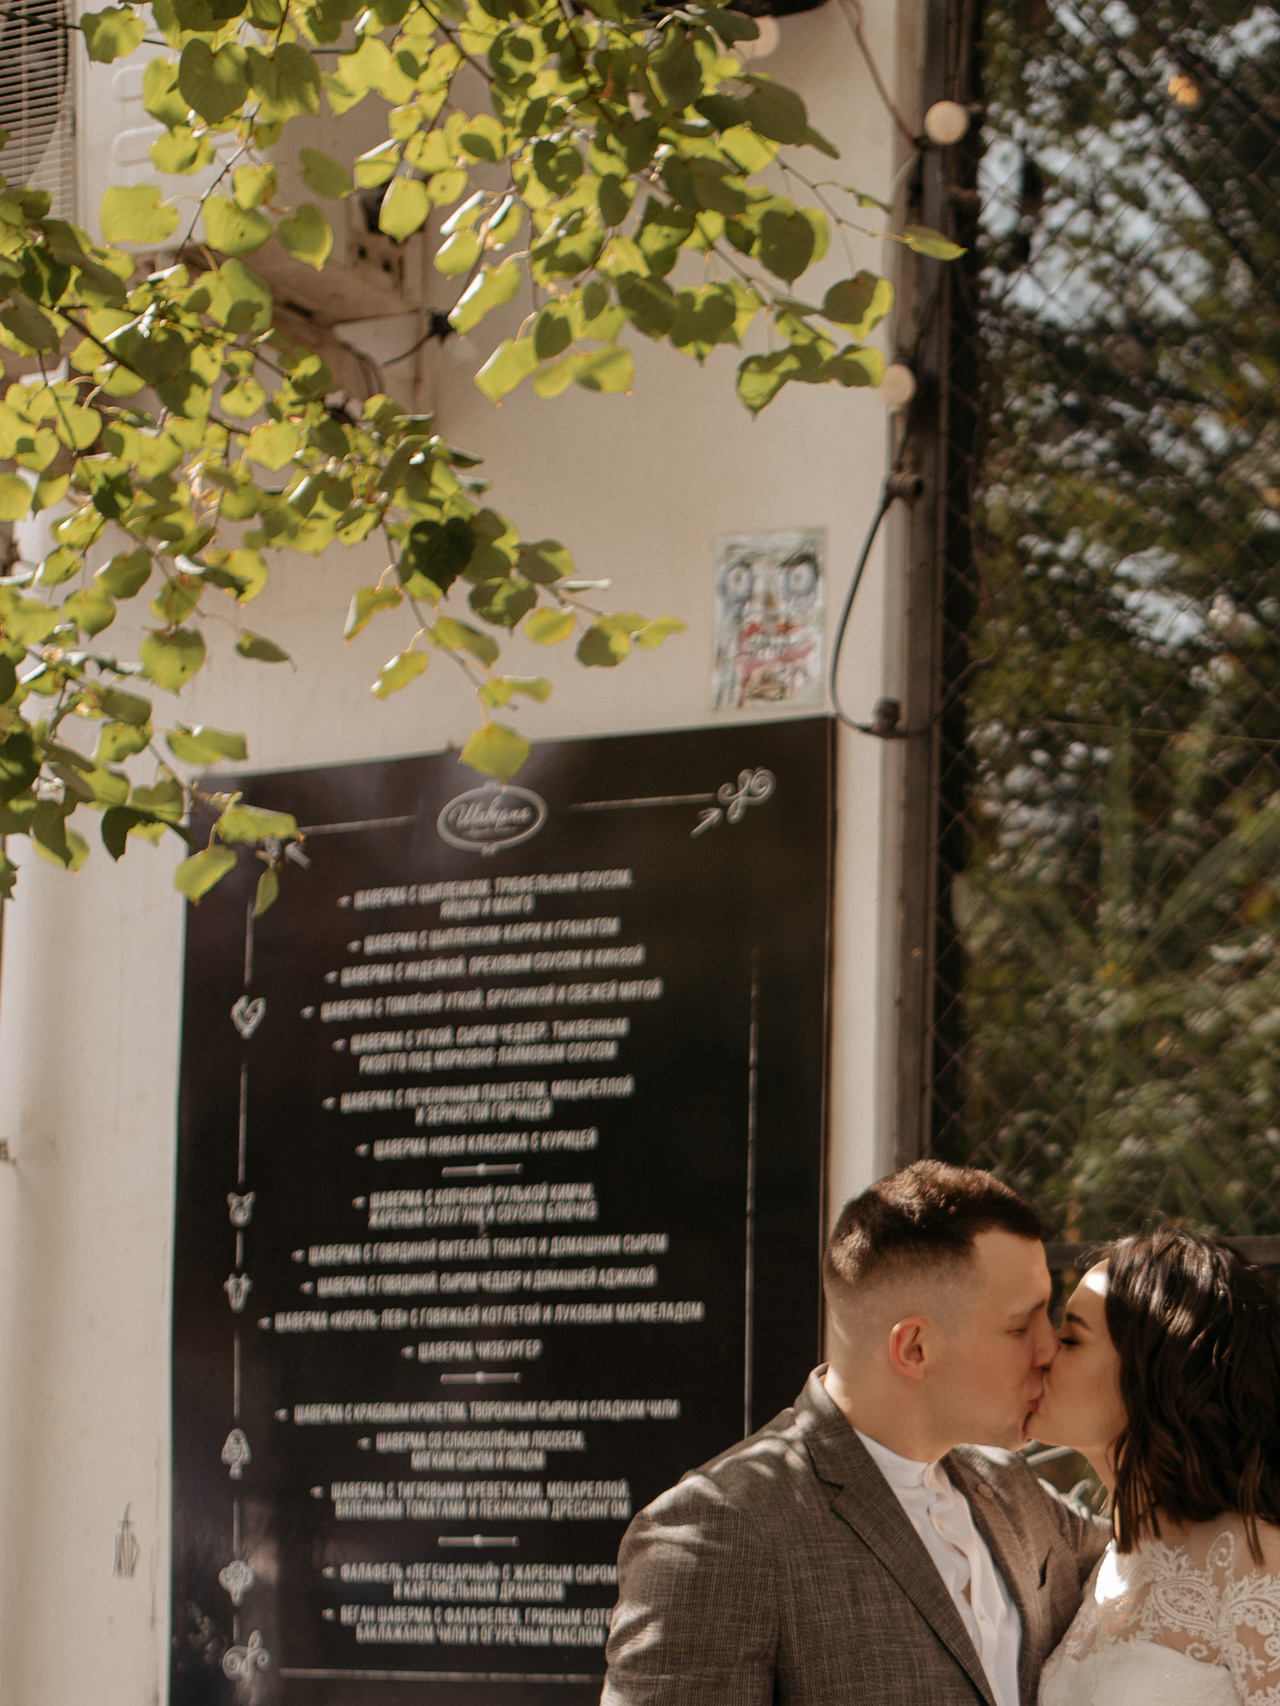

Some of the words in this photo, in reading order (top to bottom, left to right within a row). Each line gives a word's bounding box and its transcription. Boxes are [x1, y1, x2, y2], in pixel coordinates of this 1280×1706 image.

[373, 1136, 427, 1159] ШАВЕРМА
[428, 1134, 467, 1155] НОВАЯ
[467, 1131, 529, 1154] КЛАССИКА
[541, 1128, 598, 1150] КУРИЦЕЙ
[369, 1189, 424, 1209] ШАВЕРМА
[494, 1183, 549, 1204] РУЛЬКОЙ
[368, 1207, 424, 1228] ЖАРЕНЫМ
[425, 1203, 485, 1226] СУЛУГУНИ
[497, 1201, 545, 1223] СОУСОМ
[308, 1243, 361, 1264] ШАВЕРМА
[372, 1240, 438, 1262] ГОВЯДИНОЙ
[438, 1238, 491, 1260] ВИТЕЛЛО
[492, 1236, 538, 1257] ТОНАТО
[549, 1234, 622, 1256] ДОМАШНИМ
[622, 1233, 669, 1253] СЫРОМ
[316, 1275, 367, 1296] ШАВЕРМА
[439, 1271, 478, 1292] СЫРОМ
[478, 1270, 522, 1292] ЧЕДДЕР
[532, 1267, 597, 1290] ДОМАШНЕЙ
[597, 1266, 658, 1288] АДЖИКОЙ
[274, 1311, 328, 1331] ШАВЕРМА
[420, 1306, 480, 1327] ГОВЯЖЬЕЙ
[480, 1304, 542, 1325] КОТЛЕТОЙ
[553, 1303, 615, 1323] ЛУКОВЫМ
[615, 1301, 705, 1322] МАРМЕЛАДОМ
[293, 1403, 344, 1423] ШАВЕРМА
[353, 1402, 409, 1422] КРАБОВЫМ
[469, 1400, 538, 1420] ТВОРОЖНЫМ
[538, 1400, 578, 1420] СЫРОМ
[589, 1399, 646, 1419] СЛАДКИМ
[646, 1399, 680, 1417] ЧИЛИ
[375, 1431, 427, 1453] ШАВЕРМА
[442, 1430, 530, 1449] СЛАБОСОЛЁНЫМ
[410, 1449, 455, 1469] МЯГКИМ
[455, 1449, 494, 1469] СЫРОМ
[504, 1449, 546, 1469] ЯЙЦОМ
[330, 1481, 385, 1498] ШАВЕРМА
[397, 1481, 465, 1498] ТИГРОВЫМИ
[335, 1498, 405, 1518] ВЯЛЕННЫМИ
[405, 1498, 467, 1518] ТОМАТАМИ
[478, 1498, 550, 1518] ПЕКИНСКИМ
[550, 1498, 632, 1518] ДРЕССИНГОМ
[340, 1562, 403, 1583] ФАЛАФЕЛЬ
[513, 1564, 574, 1581] ЖАРЕНЫМ
[575, 1564, 617, 1583] СЫРОМ
[403, 1580, 499, 1600] КАРТОФЕЛЬНЫМ
[499, 1580, 566, 1601] ДРАНИКОМ
[340, 1605, 375, 1626] ВЕГАН
[376, 1606, 433, 1623] ШАВЕРМА
[524, 1608, 582, 1626] ГРИБНЫМ
[583, 1608, 612, 1625] СОТЕ
[355, 1622, 436, 1643] БАКЛАЖАНОМ
[436, 1623, 469, 1643] ЧИЛИ
[479, 1623, 550, 1644] ОГУРЕЧНЫМ
[551, 1624, 606, 1645] МАСЛОМ
